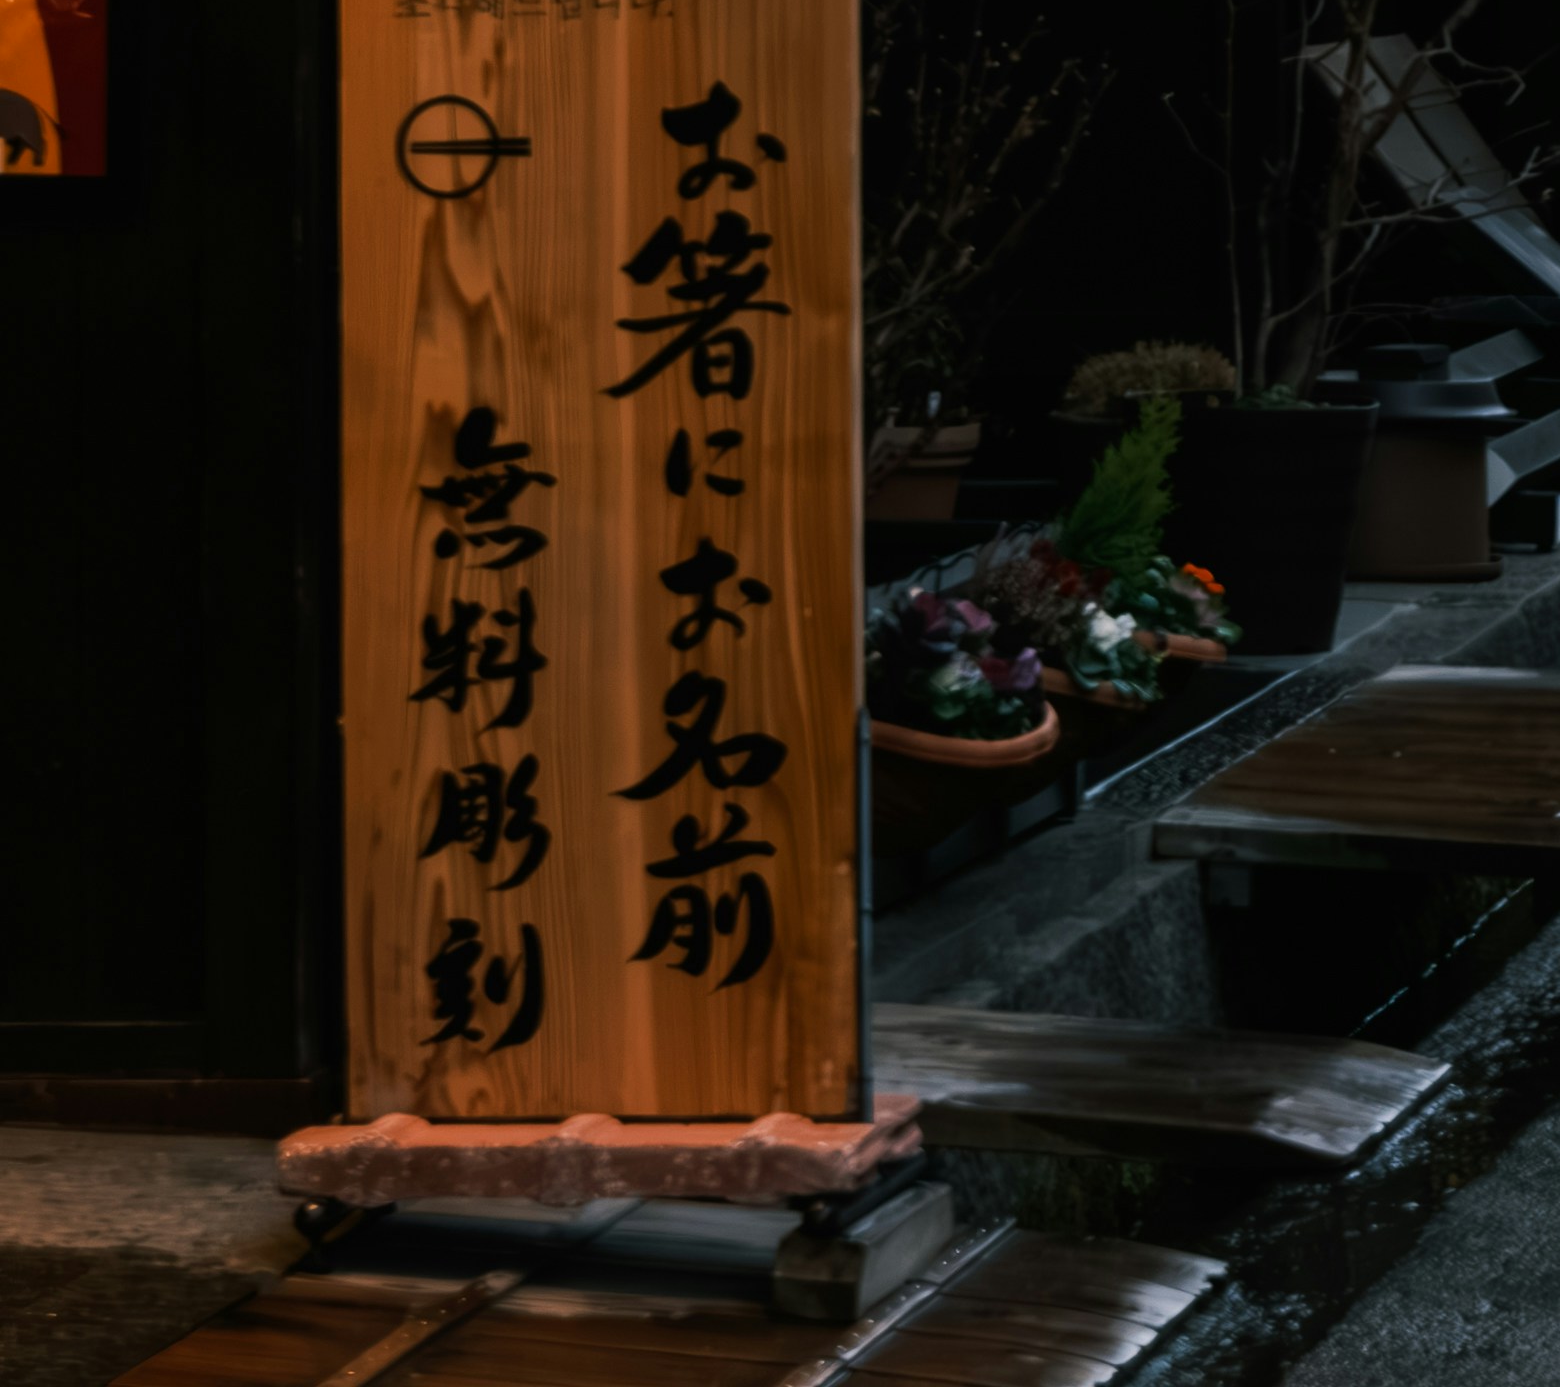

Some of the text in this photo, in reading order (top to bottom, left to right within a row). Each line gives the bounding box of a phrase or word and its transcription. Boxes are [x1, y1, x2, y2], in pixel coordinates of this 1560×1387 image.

[408, 405, 558, 1054] 無料彫刻
[602, 81, 791, 990] お箸にお名前
